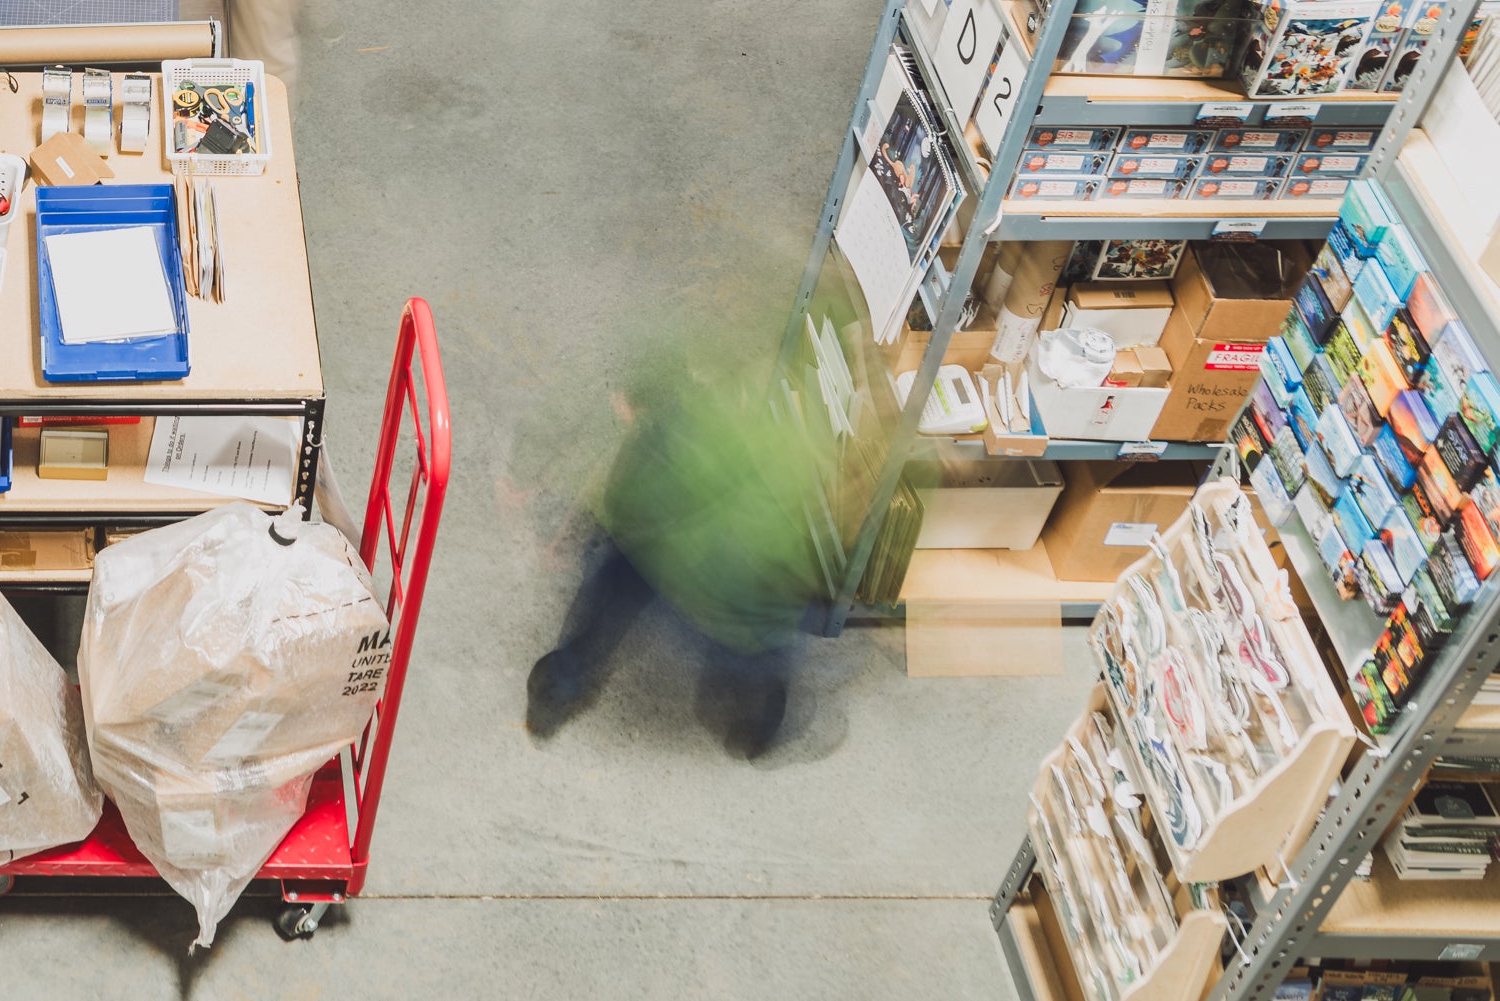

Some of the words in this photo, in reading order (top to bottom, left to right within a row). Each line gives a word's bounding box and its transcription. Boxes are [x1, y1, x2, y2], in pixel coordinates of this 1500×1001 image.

[1214, 353, 1261, 362] FRAGIL
[1188, 384, 1248, 397] Wholesale
[1187, 397, 1226, 411] Packs
[348, 668, 384, 682] TARE
[342, 682, 378, 696] 2022
